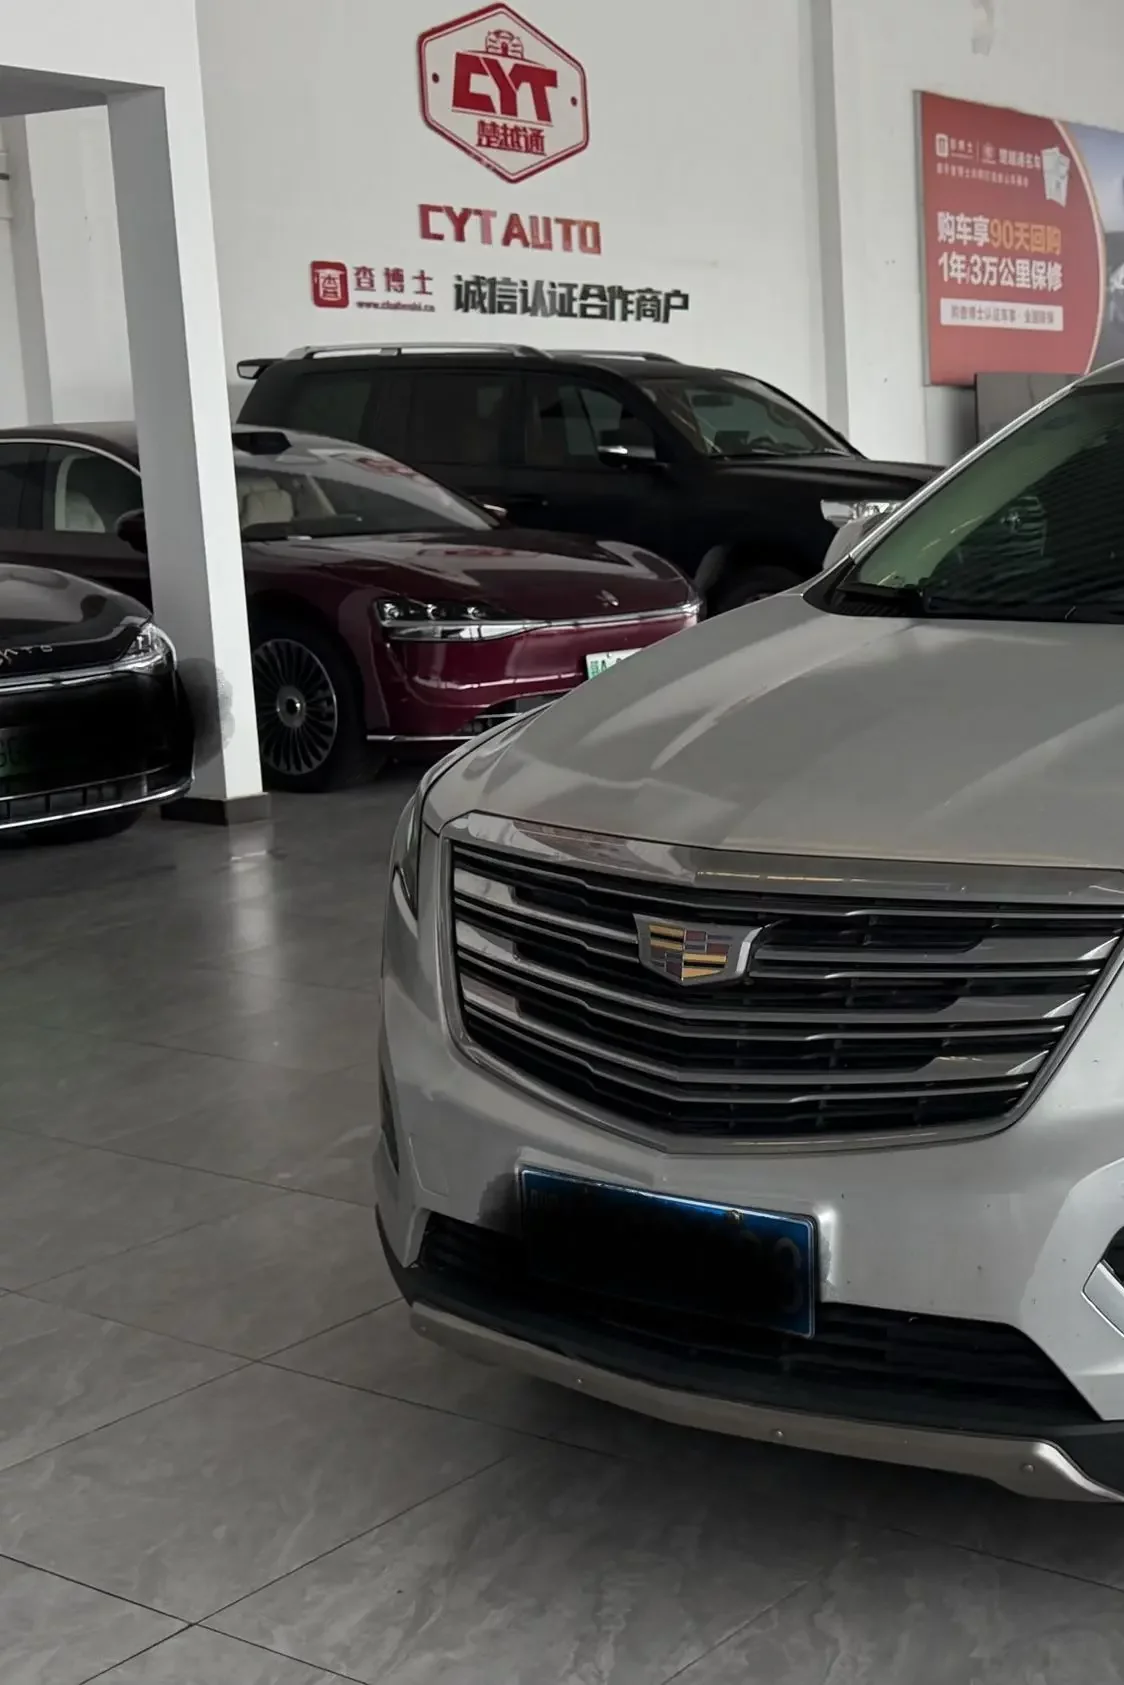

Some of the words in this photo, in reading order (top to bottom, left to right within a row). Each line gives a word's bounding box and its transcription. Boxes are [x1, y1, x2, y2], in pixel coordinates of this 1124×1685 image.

[452, 51, 558, 123] CYT
[476, 119, 547, 156] 楚越通
[418, 203, 497, 245] CYT
[502, 213, 602, 255] AUTO
[937, 210, 1062, 256] 购车享90天回购
[352, 265, 434, 295] 查博士
[453, 274, 690, 323] 诚信认证合作商户
